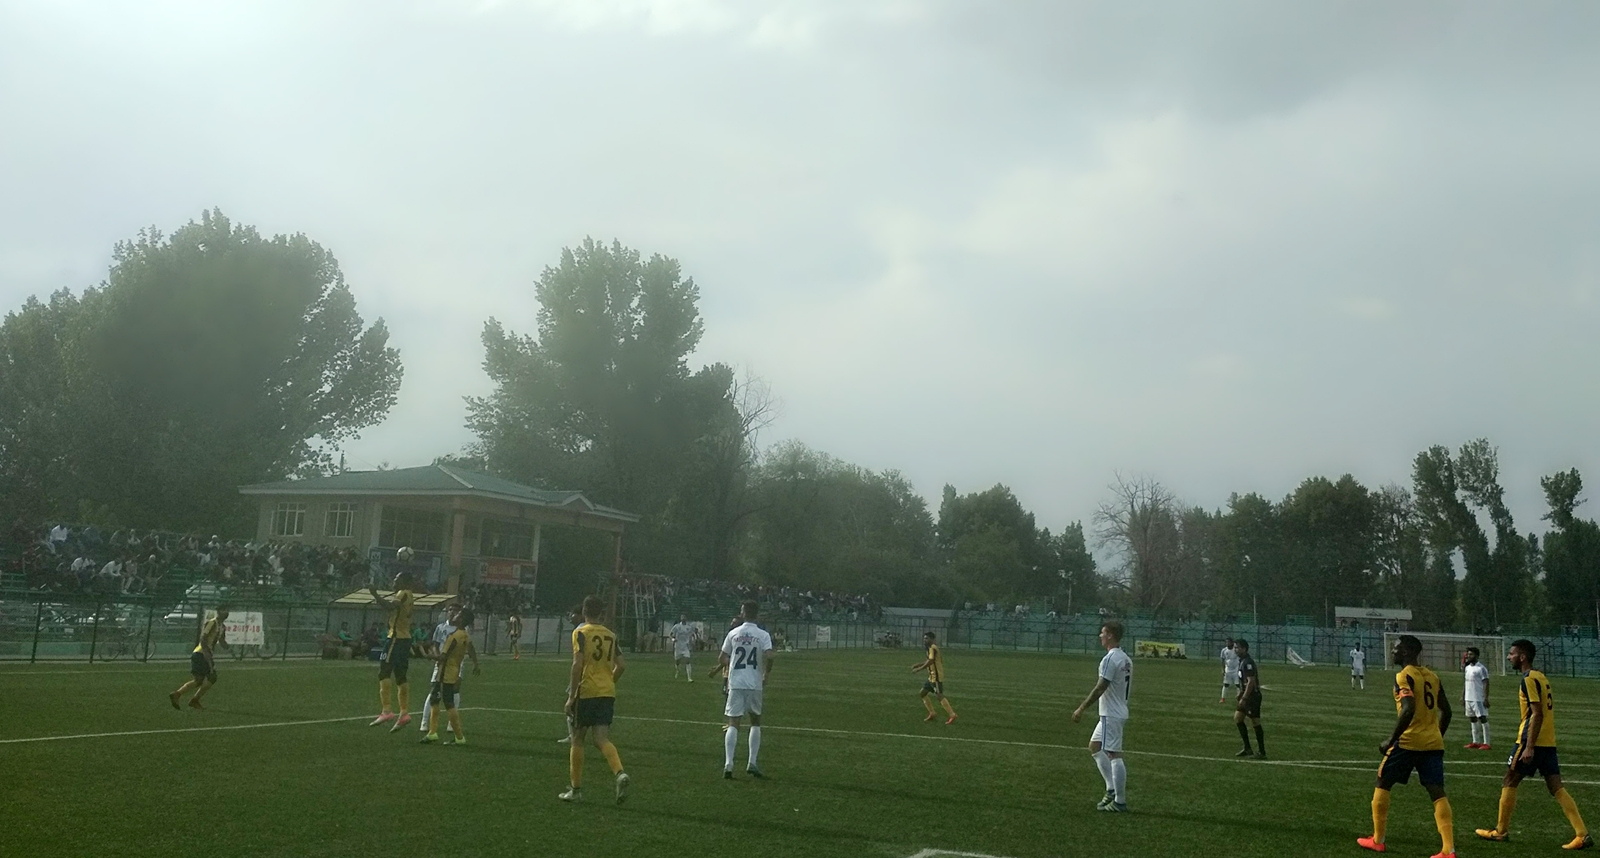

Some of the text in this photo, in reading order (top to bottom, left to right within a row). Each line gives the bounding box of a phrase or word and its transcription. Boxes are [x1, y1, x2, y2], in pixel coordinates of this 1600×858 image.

[592, 635, 613, 661] 37
[734, 646, 757, 669] 24
[1424, 681, 1434, 710] 6
